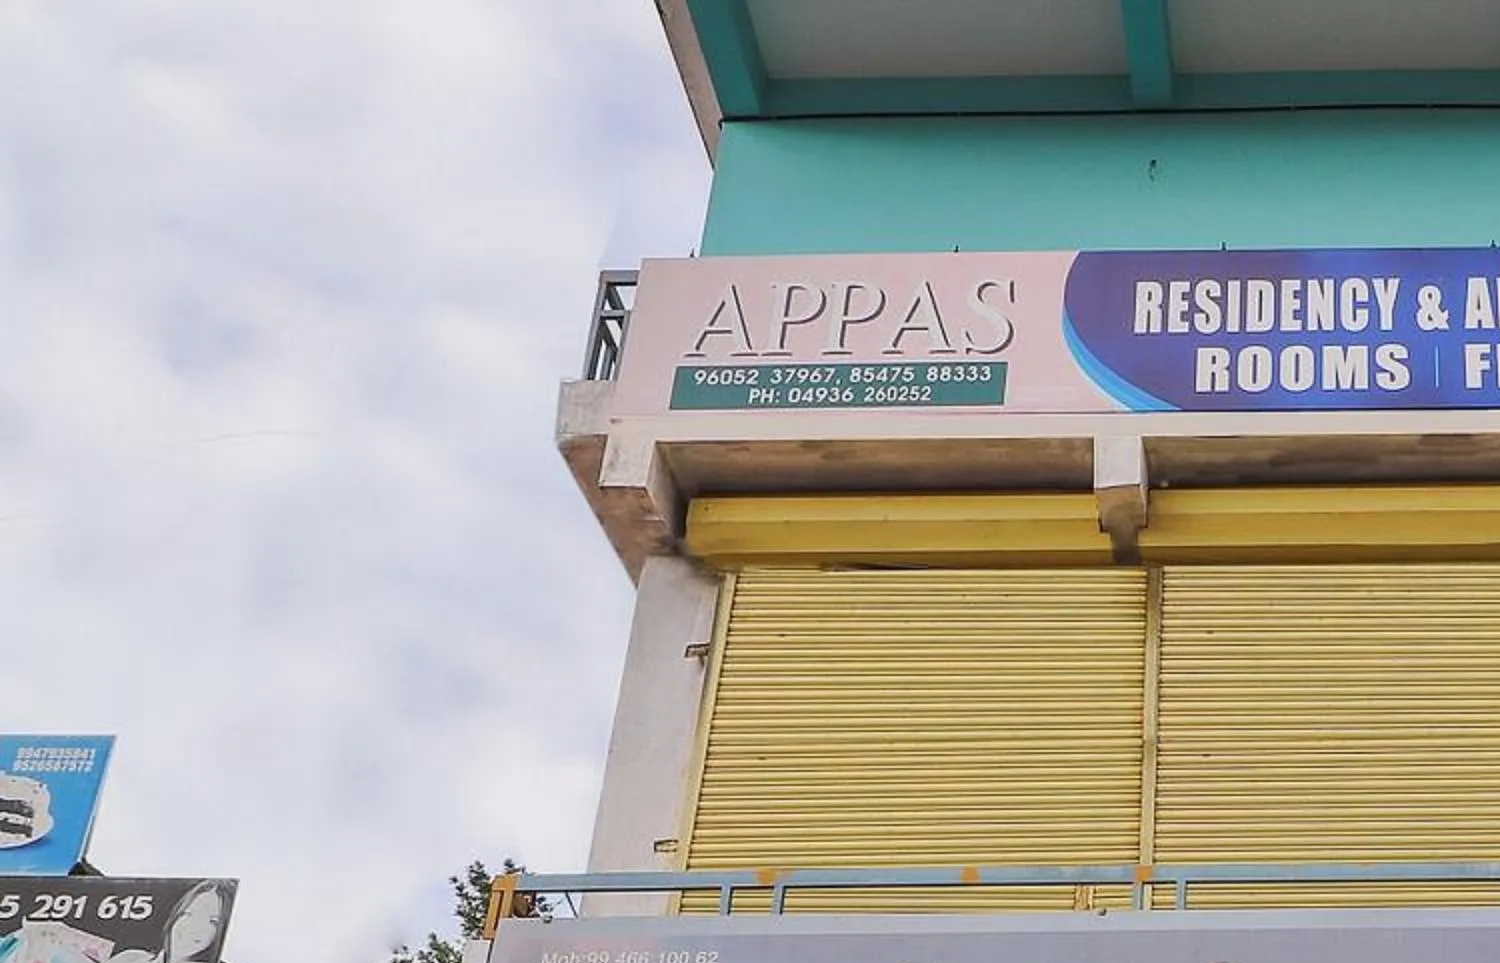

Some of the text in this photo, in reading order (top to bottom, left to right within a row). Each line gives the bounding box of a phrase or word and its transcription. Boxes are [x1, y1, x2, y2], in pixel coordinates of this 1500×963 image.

[683, 279, 1016, 358] APPAS
[1132, 277, 1401, 335] RESIDENCY
[1416, 284, 1450, 331] &
[693, 363, 993, 387] 96052 37967, 85475 88333
[1194, 343, 1411, 394] ROOMS
[747, 384, 933, 404] PH: 04936 260252
[27, 894, 88, 920] 291
[97, 895, 154, 920] 615
